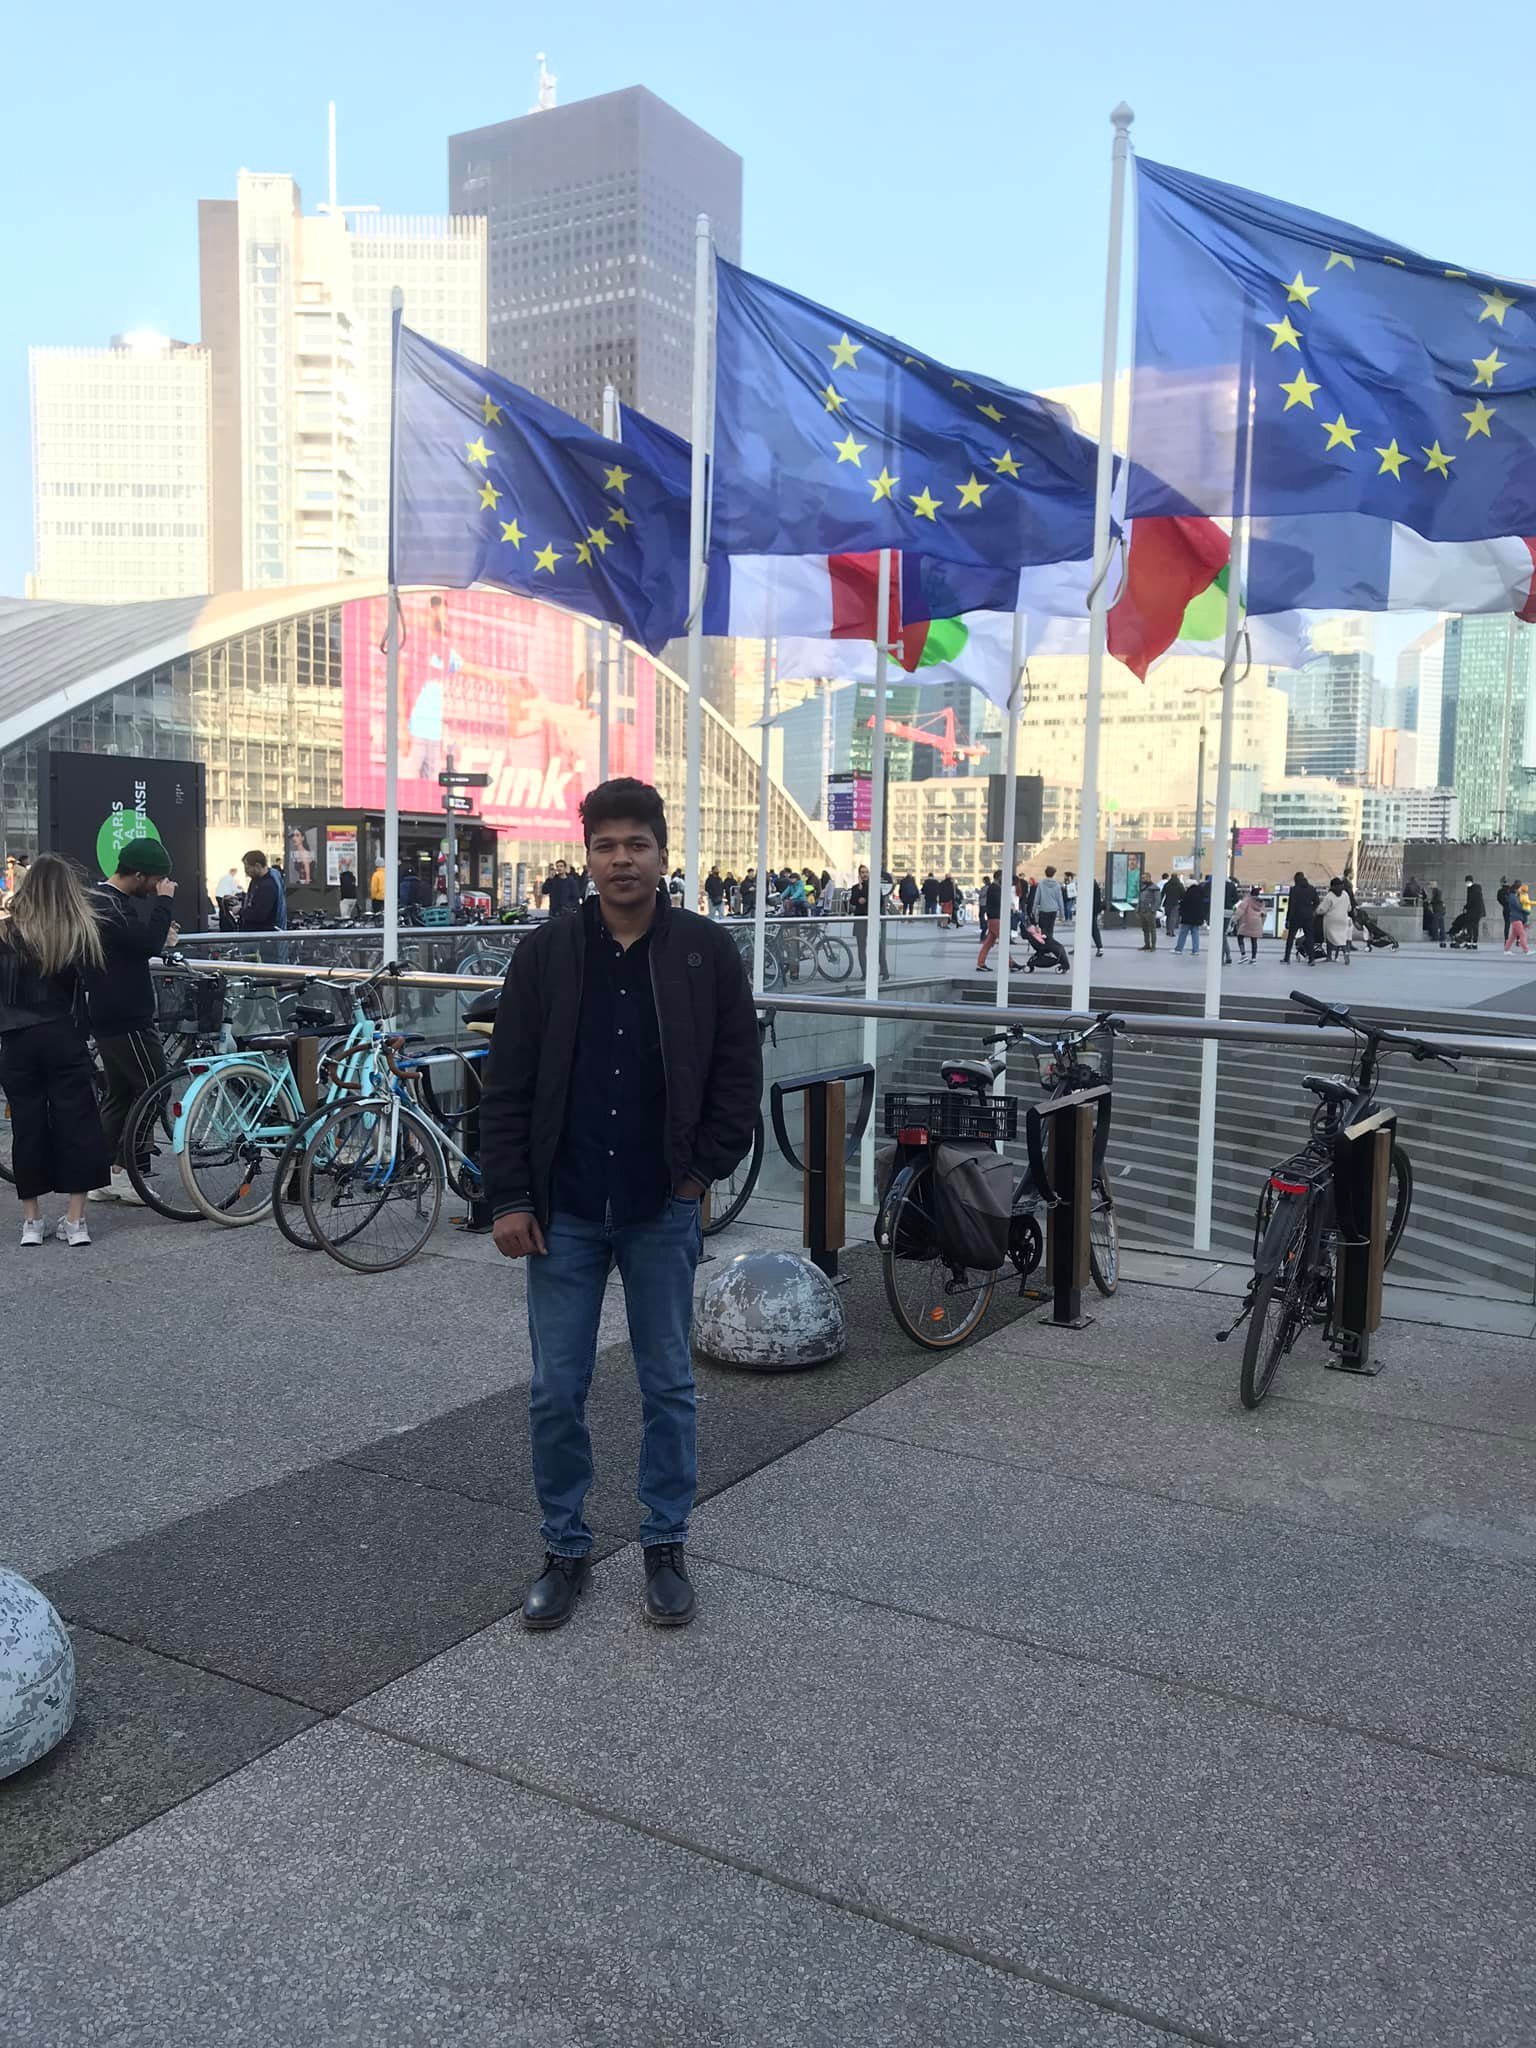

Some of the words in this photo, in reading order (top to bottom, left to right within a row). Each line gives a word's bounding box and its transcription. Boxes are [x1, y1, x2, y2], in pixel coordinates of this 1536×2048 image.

[453, 748, 585, 810] Flink
[112, 801, 123, 850] PARIS
[125, 828, 135, 840] A
[135, 781, 146, 839] EFENSE
